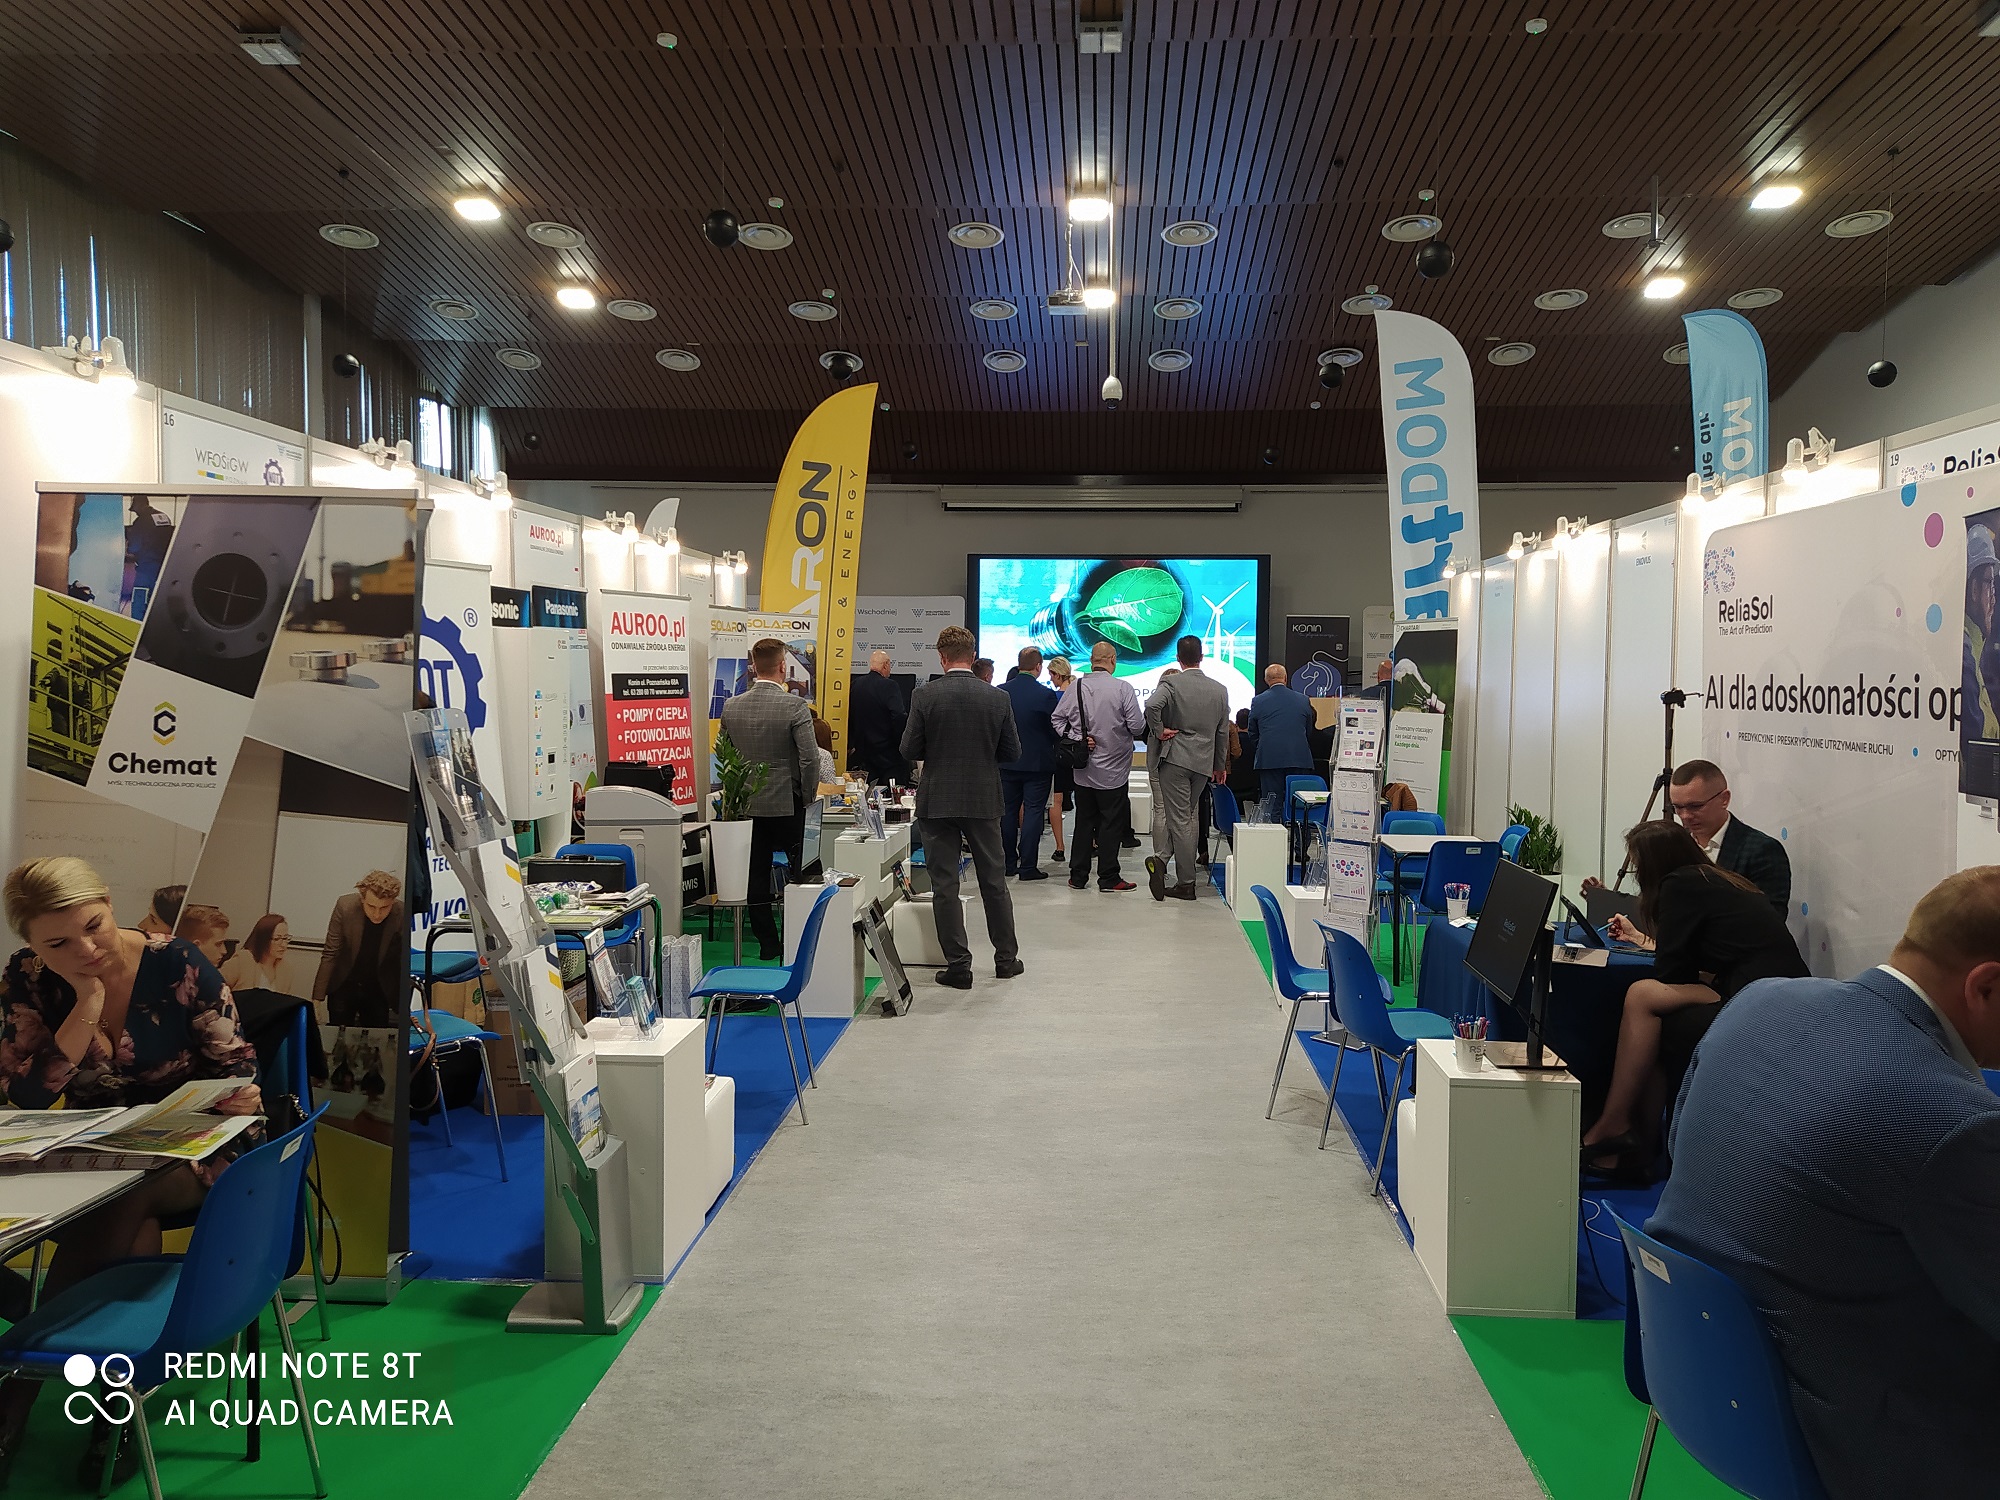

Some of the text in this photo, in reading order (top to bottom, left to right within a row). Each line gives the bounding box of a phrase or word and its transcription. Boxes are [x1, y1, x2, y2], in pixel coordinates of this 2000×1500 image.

[163, 412, 175, 427] 16
[1890, 453, 1900, 467] 19
[1943, 446, 2000, 475] Relia
[841, 468, 859, 579] ENERGY
[529, 524, 565, 548] AUROO.pl
[491, 599, 520, 621] sonic
[544, 598, 580, 617] Panasonic
[857, 607, 898, 616] Wschodniej
[1718, 594, 1773, 624] ReliaSol
[610, 611, 686, 643] AUROO.pl
[747, 618, 811, 631] SOLARON
[1719, 623, 1773, 636] The Art of Prediction
[1704, 674, 1724, 710] AI
[1729, 673, 1757, 712] dla
[1761, 672, 1920, 720] doskonałości
[622, 706, 689, 723] POMPY CIEPŁA
[624, 726, 692, 744] FOTOWOLTAIKA
[625, 746, 692, 763] KLIMATYZACJA
[1824, 739, 1869, 754] UTRZYMANIE
[1868, 743, 1894, 756] RUCHU
[108, 751, 218, 777] Chemat
